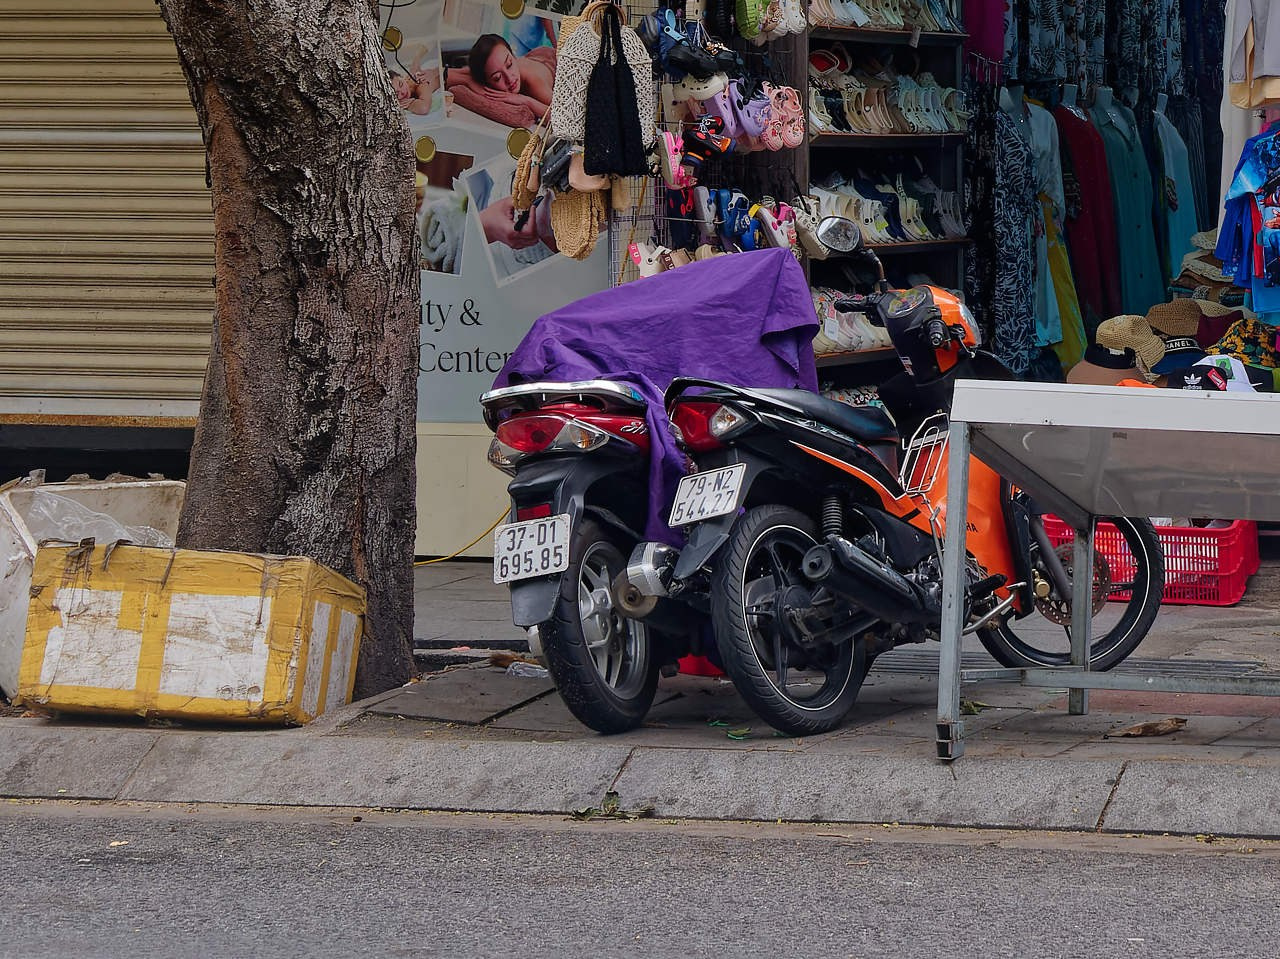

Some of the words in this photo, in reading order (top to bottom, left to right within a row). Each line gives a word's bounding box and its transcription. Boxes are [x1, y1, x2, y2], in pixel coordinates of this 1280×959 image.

[459, 298, 484, 326] &
[687, 471, 734, 498] 79-N2
[674, 490, 734, 522] 544.27
[506, 521, 556, 552] 37-D1
[499, 545, 563, 578] 695.85
